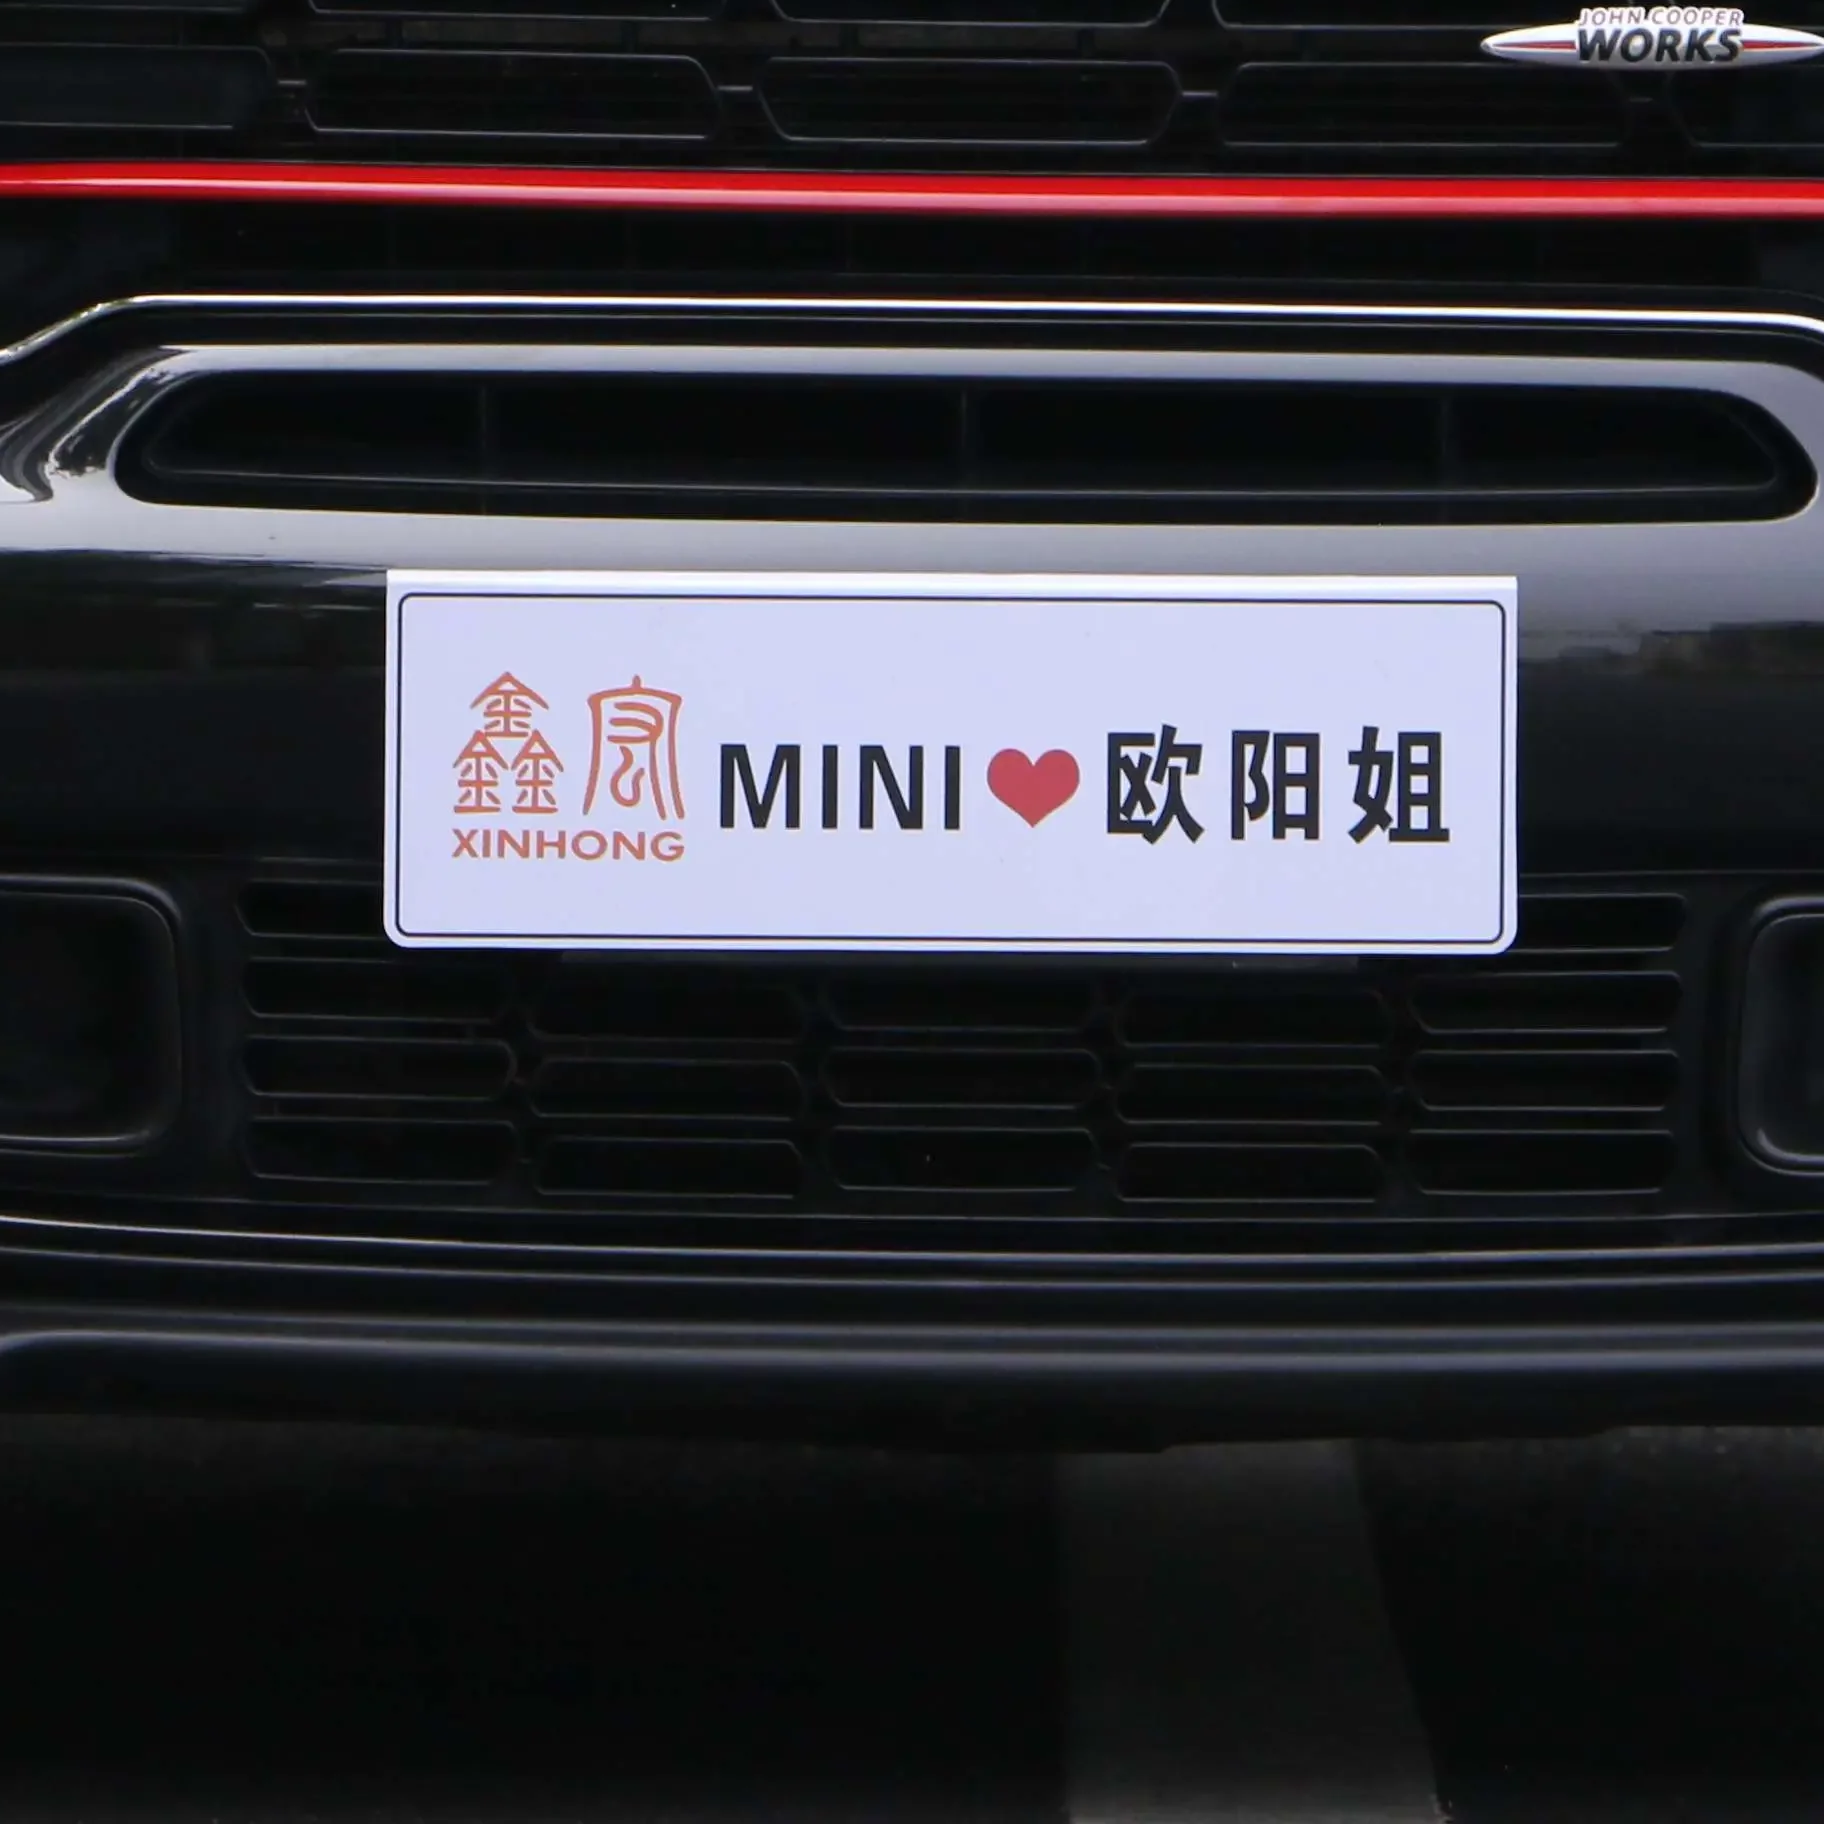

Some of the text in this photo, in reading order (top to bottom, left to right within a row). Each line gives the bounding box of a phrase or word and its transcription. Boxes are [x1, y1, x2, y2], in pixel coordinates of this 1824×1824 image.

[1578, 7, 1744, 25] JOHN COOPER
[1577, 27, 1743, 63] WORKS
[719, 723, 1451, 845] MINI 欧阳姐
[451, 827, 687, 862] XINHONG
